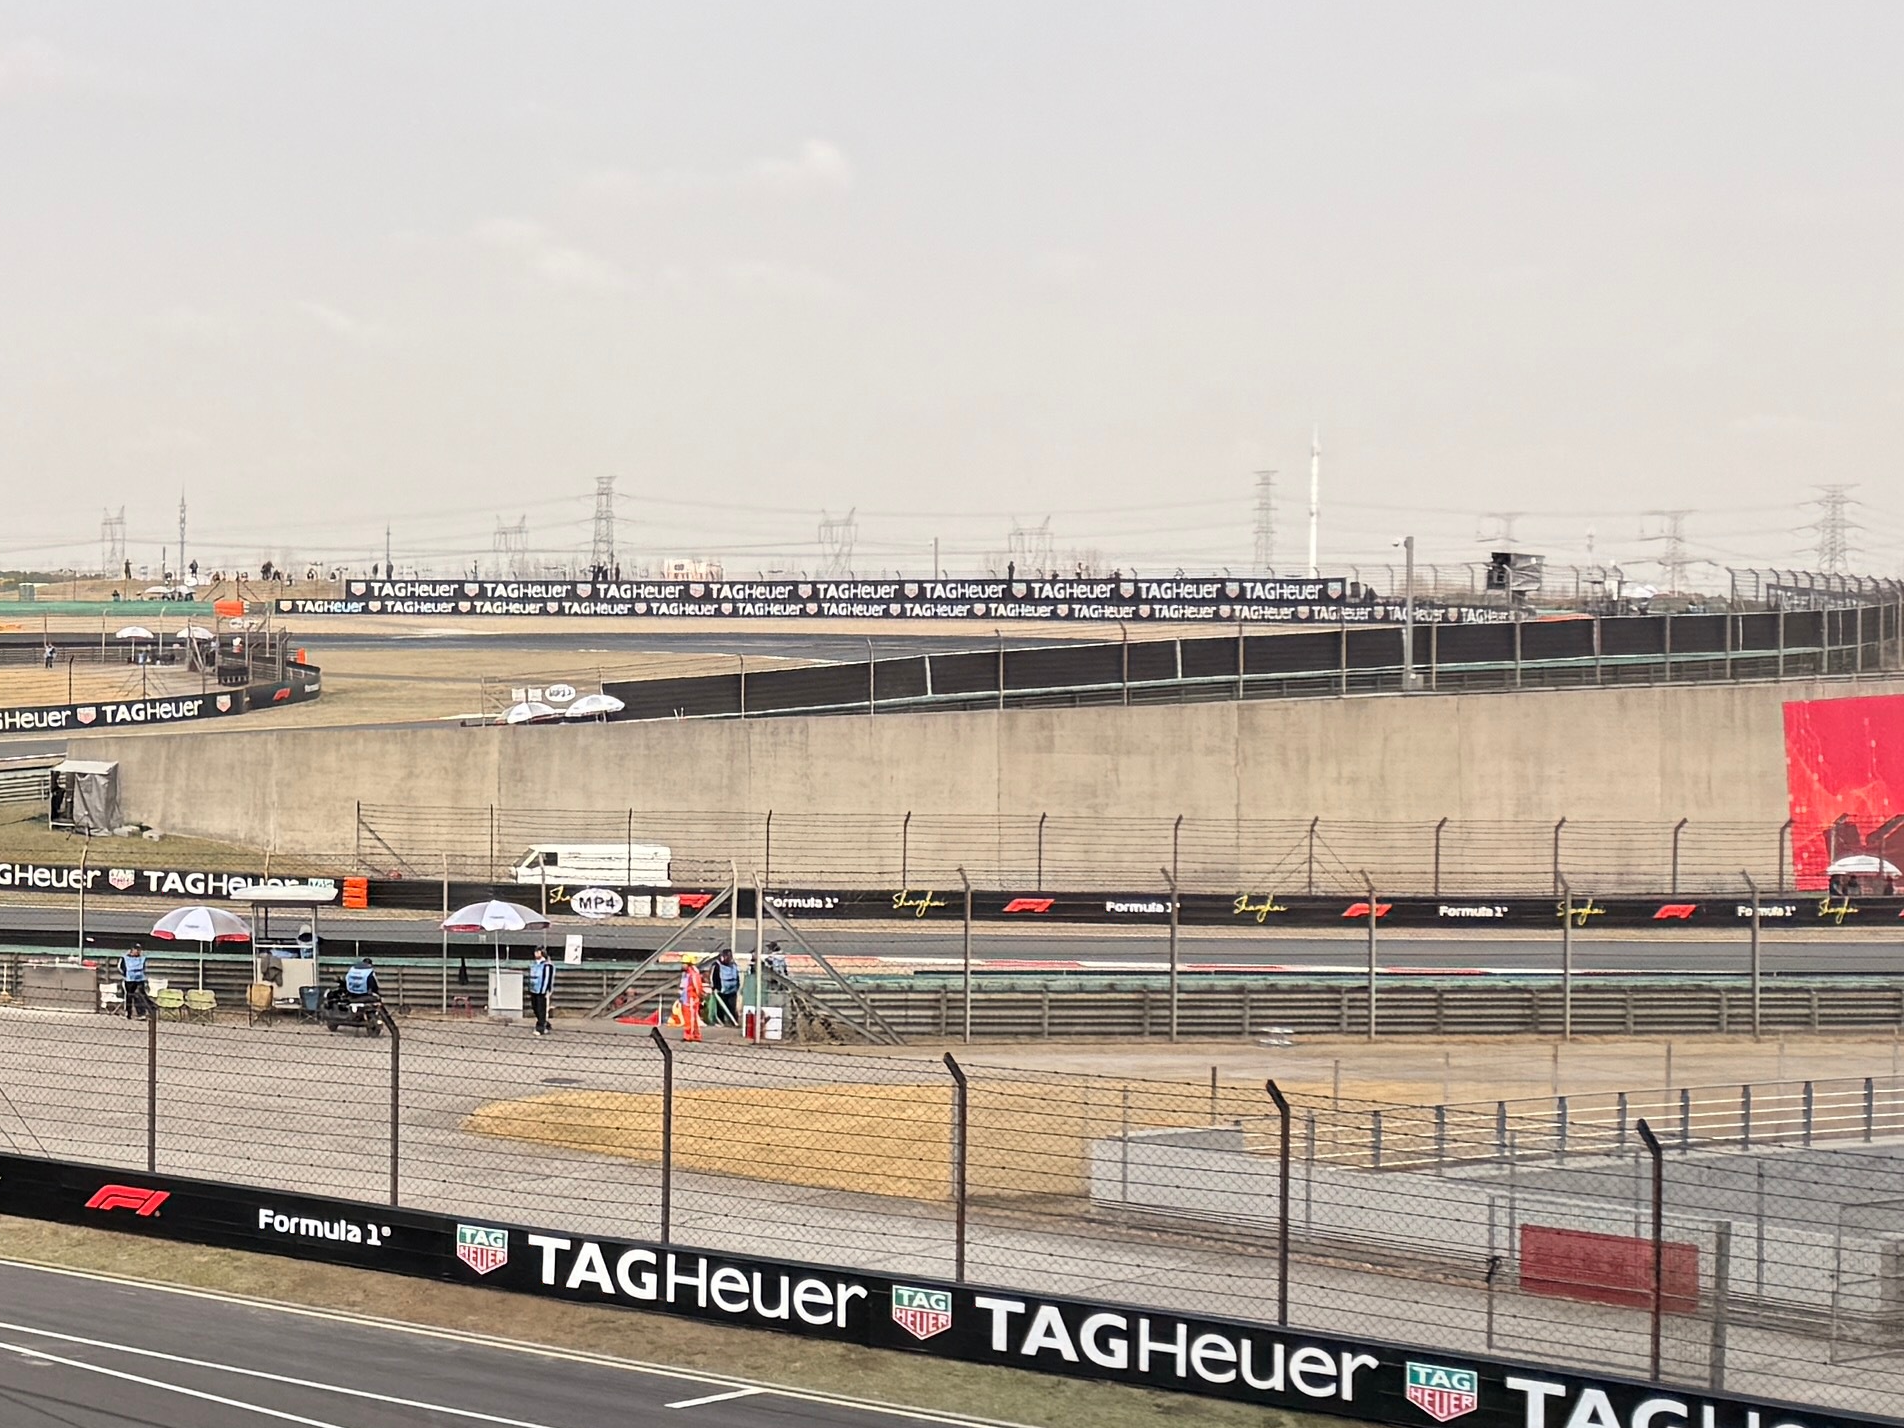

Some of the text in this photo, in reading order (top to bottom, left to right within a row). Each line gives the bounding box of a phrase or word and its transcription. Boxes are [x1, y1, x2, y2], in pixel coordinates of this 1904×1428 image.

[371, 582, 458, 597] TAGHeuer
[484, 583, 571, 598] TAGHeuer
[597, 584, 684, 599] TAGHeuer
[710, 584, 793, 599] TAGHeuer
[817, 584, 899, 599] TAGHeuer
[924, 584, 1007, 599] TAGHeuer
[1031, 584, 1115, 599] TAGHeuer
[1139, 583, 1221, 599] TAGHeuer
[1243, 583, 1323, 599] TAGHeuer
[296, 602, 365, 614] TAGHeuer
[103, 698, 202, 722] TAGHeuer
[578, 896, 615, 910] MP4
[1105, 901, 1164, 913] Formula
[1439, 906, 1493, 917] Formula
[259, 1208, 361, 1244] Formula
[460, 1227, 504, 1248] TAG
[458, 1244, 505, 1271] HEUER
[528, 1234, 868, 1328] TAGHeuer
[898, 1289, 947, 1310] TAG
[895, 1306, 950, 1336] HEUER
[975, 1296, 1379, 1401] TAGHeuer
[1412, 1366, 1472, 1391] TAG
[1409, 1386, 1474, 1417] HEUER
